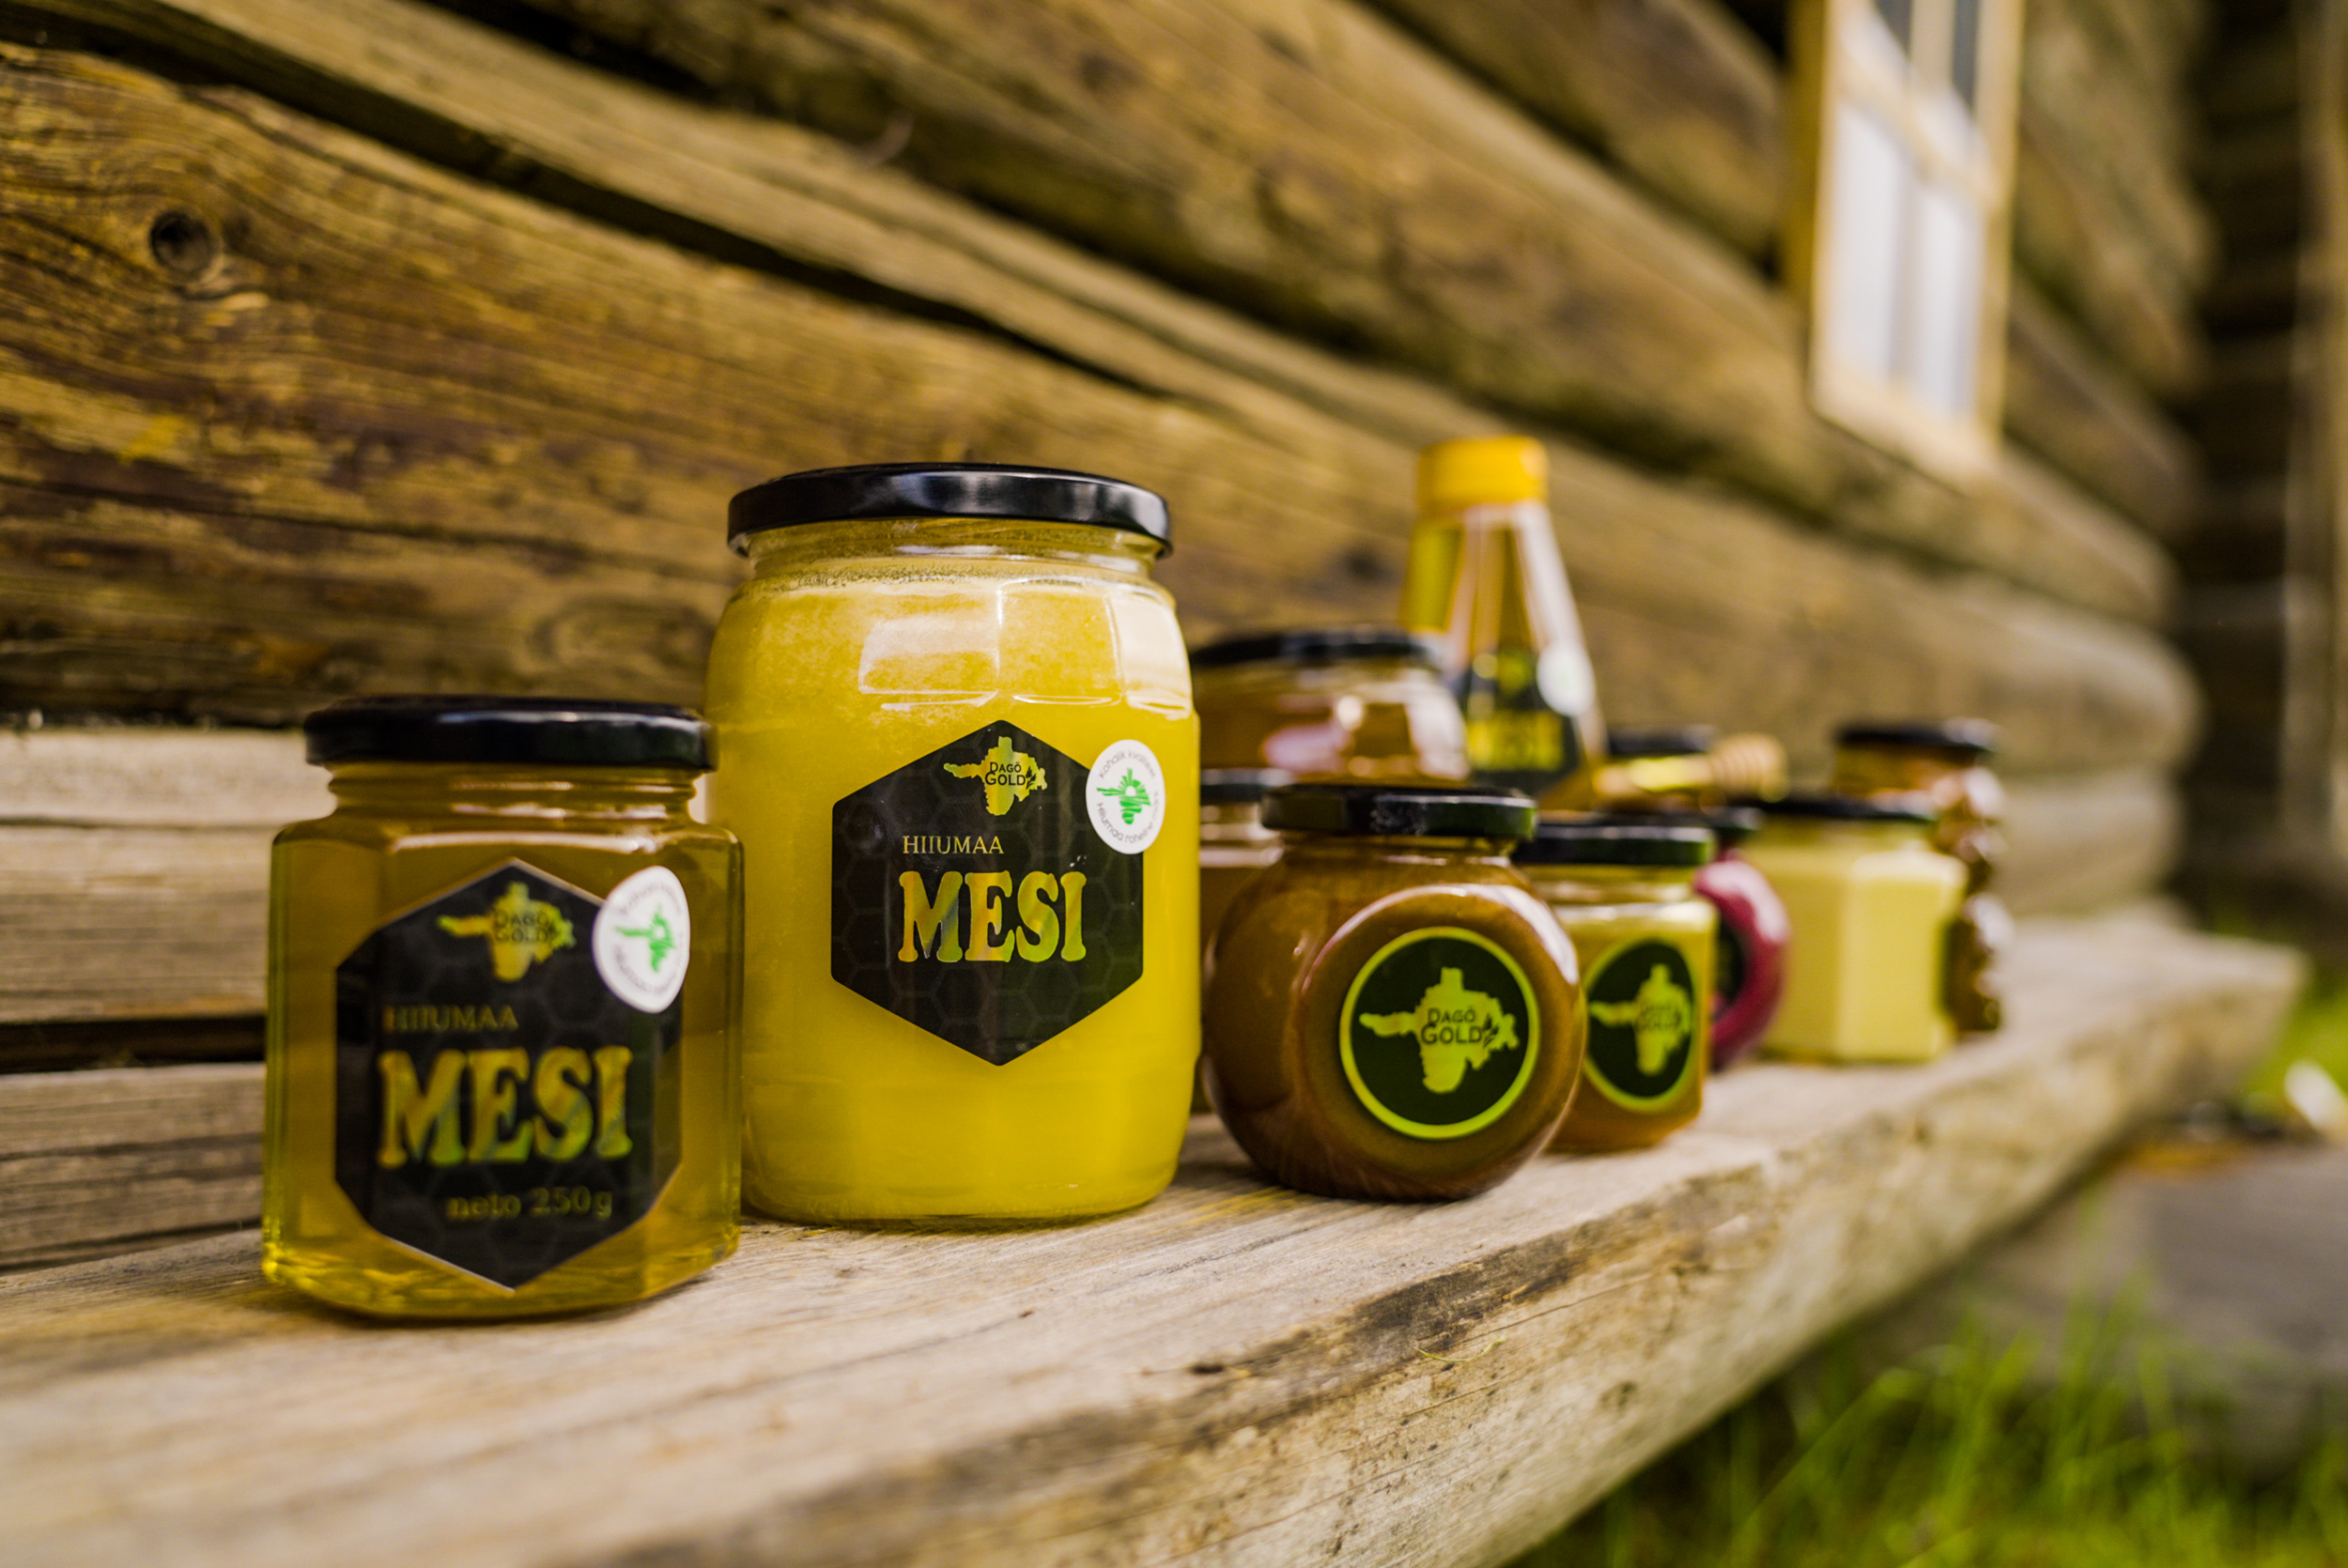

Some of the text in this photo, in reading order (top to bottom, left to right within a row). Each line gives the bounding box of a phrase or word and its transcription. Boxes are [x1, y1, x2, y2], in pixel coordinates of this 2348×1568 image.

[984, 771, 1027, 786] GOLD
[1096, 802, 1124, 841] Hiiumaa
[903, 835, 1005, 855] HIIUMAA
[897, 870, 1087, 963] MESI
[381, 1005, 519, 1032] HIIUMAA
[1420, 1022, 1483, 1044] GOLD
[377, 1045, 634, 1168] MESI
[444, 1191, 522, 1220] neto
